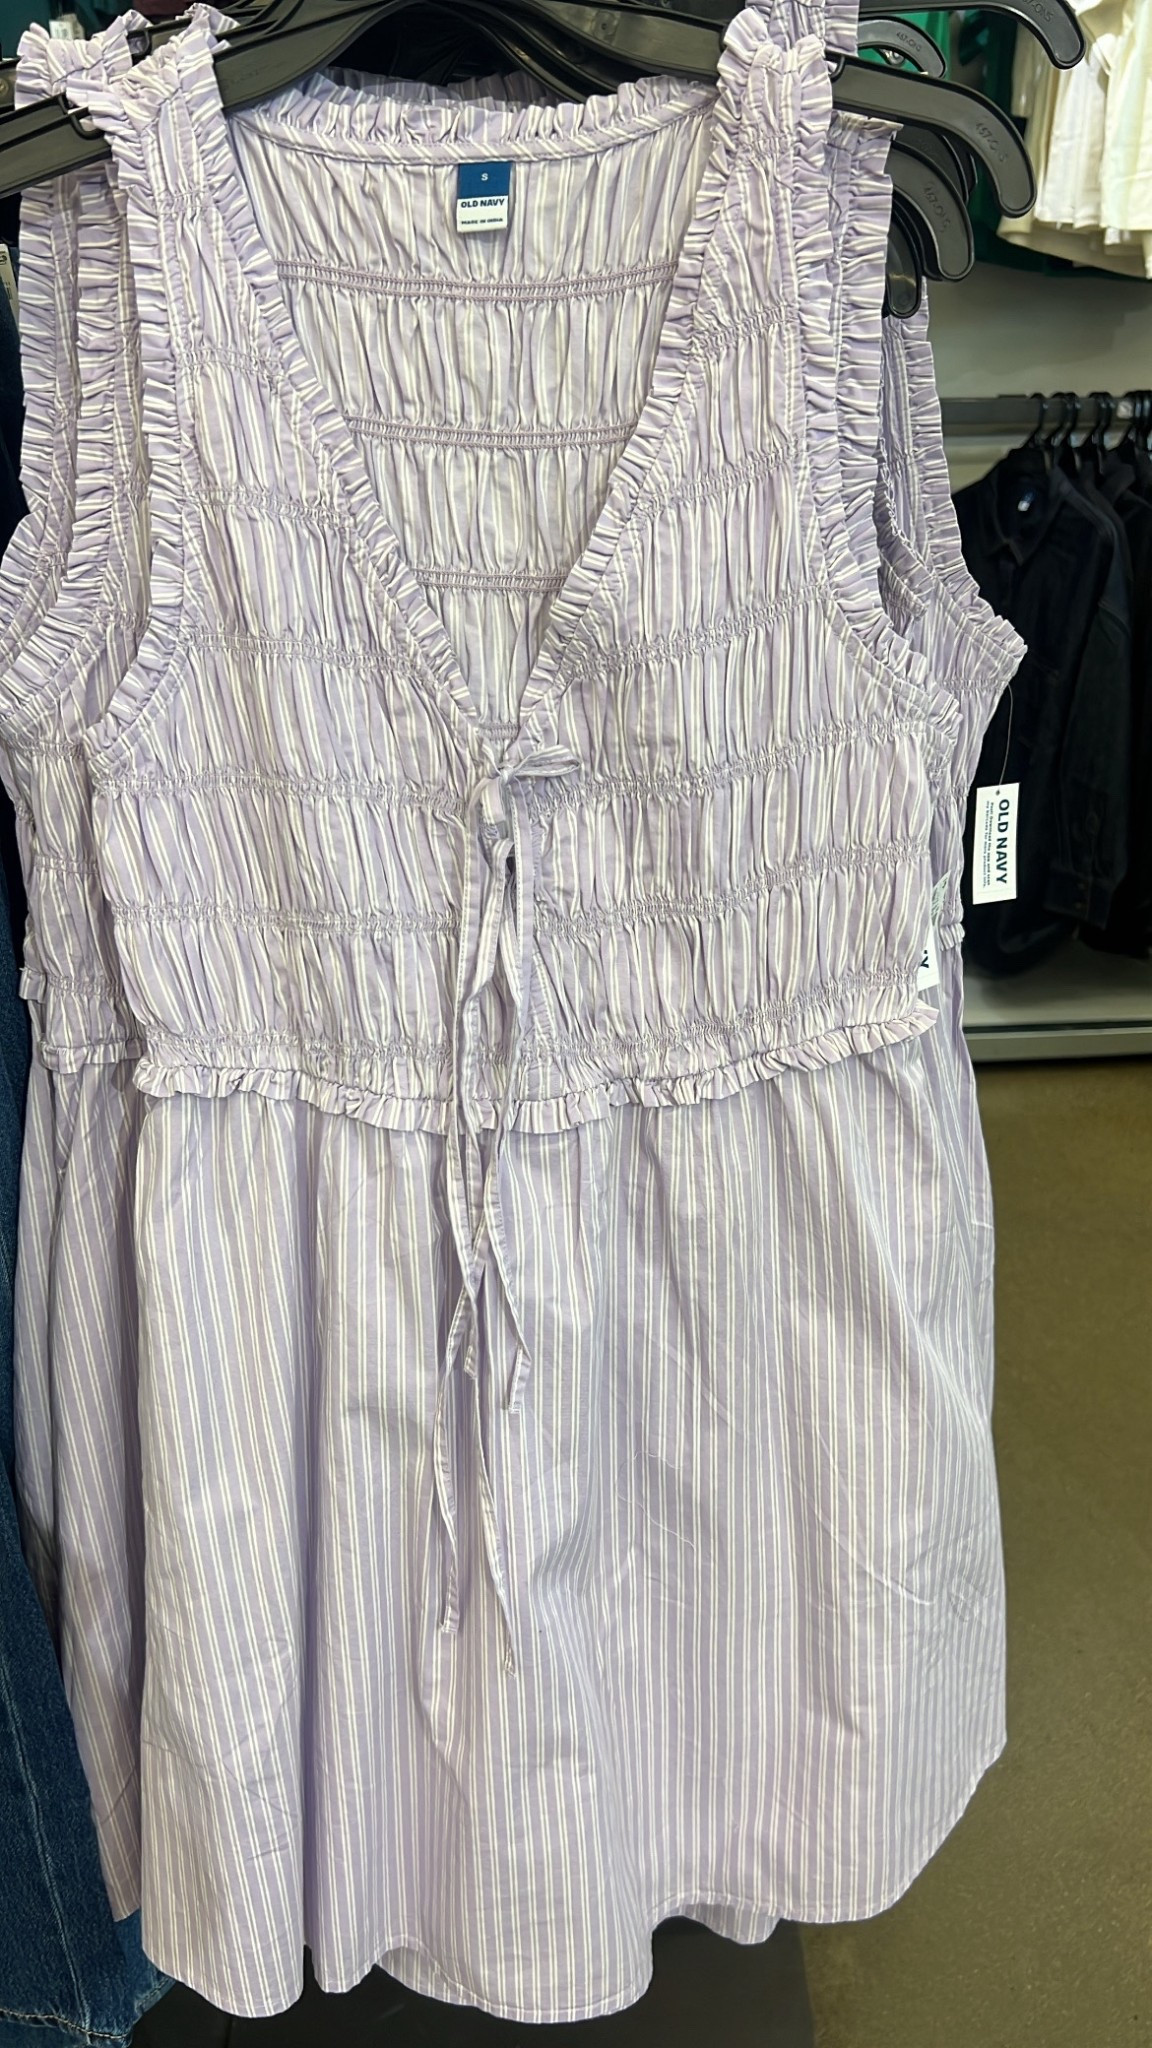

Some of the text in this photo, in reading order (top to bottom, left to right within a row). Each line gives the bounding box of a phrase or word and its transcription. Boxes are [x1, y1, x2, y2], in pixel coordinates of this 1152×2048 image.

[481, 173, 488, 181] S
[461, 198, 505, 208] OLD NAVY
[996, 799, 1009, 884] OLD NAVY
